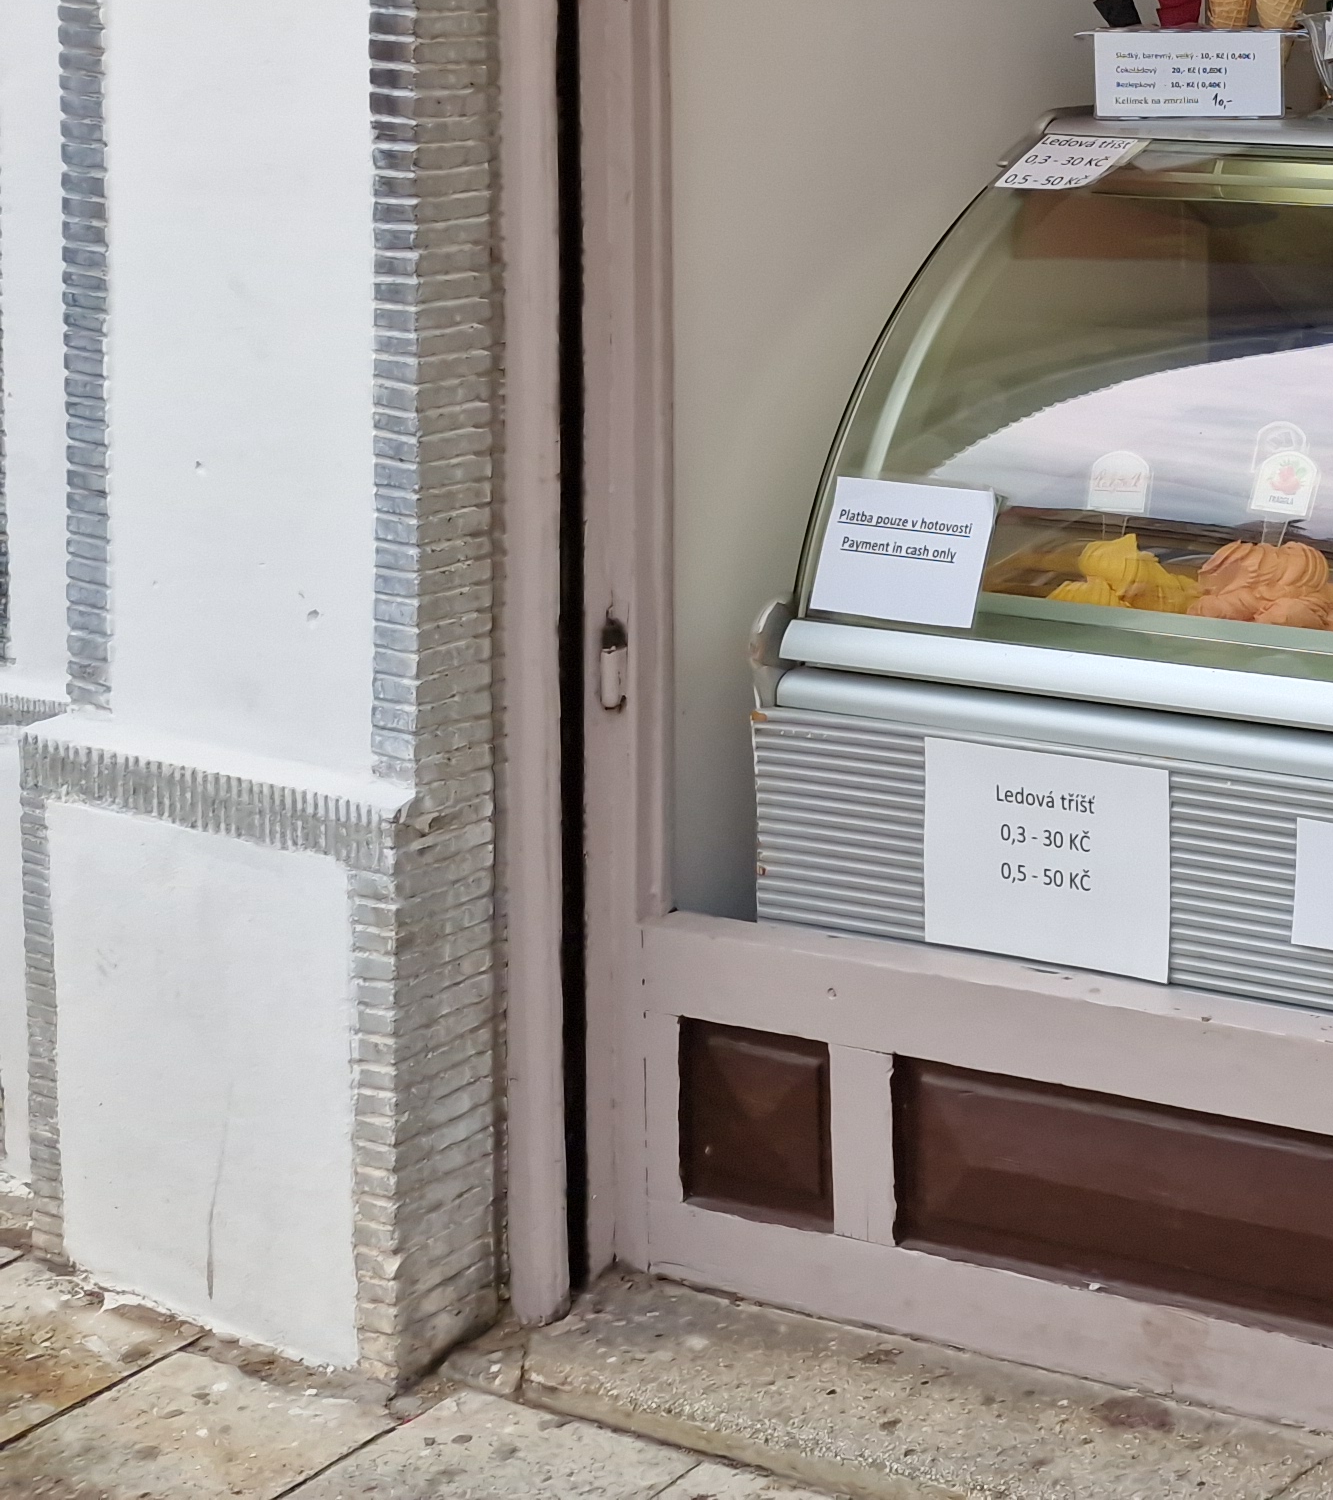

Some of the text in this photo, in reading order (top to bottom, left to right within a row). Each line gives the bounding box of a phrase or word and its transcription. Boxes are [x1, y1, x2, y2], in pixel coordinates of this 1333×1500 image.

[1041, 136, 1097, 149] Ledová
[1025, 154, 1052, 166] 0,3
[1061, 156, 1084, 166] 30
[1004, 173, 1033, 185] 0,5
[1041, 175, 1064, 186] 50
[838, 508, 974, 535] Platba pouze v hotovosti
[841, 536, 958, 563] Payment in cash only
[995, 784, 1096, 815] Ledová tříšť
[999, 823, 1027, 846] 0,3
[1042, 829, 1064, 849] 30
[1068, 830, 1092, 853] KČ
[999, 862, 1027, 884] 0,5
[1042, 868, 1064, 888] 50
[1068, 869, 1092, 892] KČ
